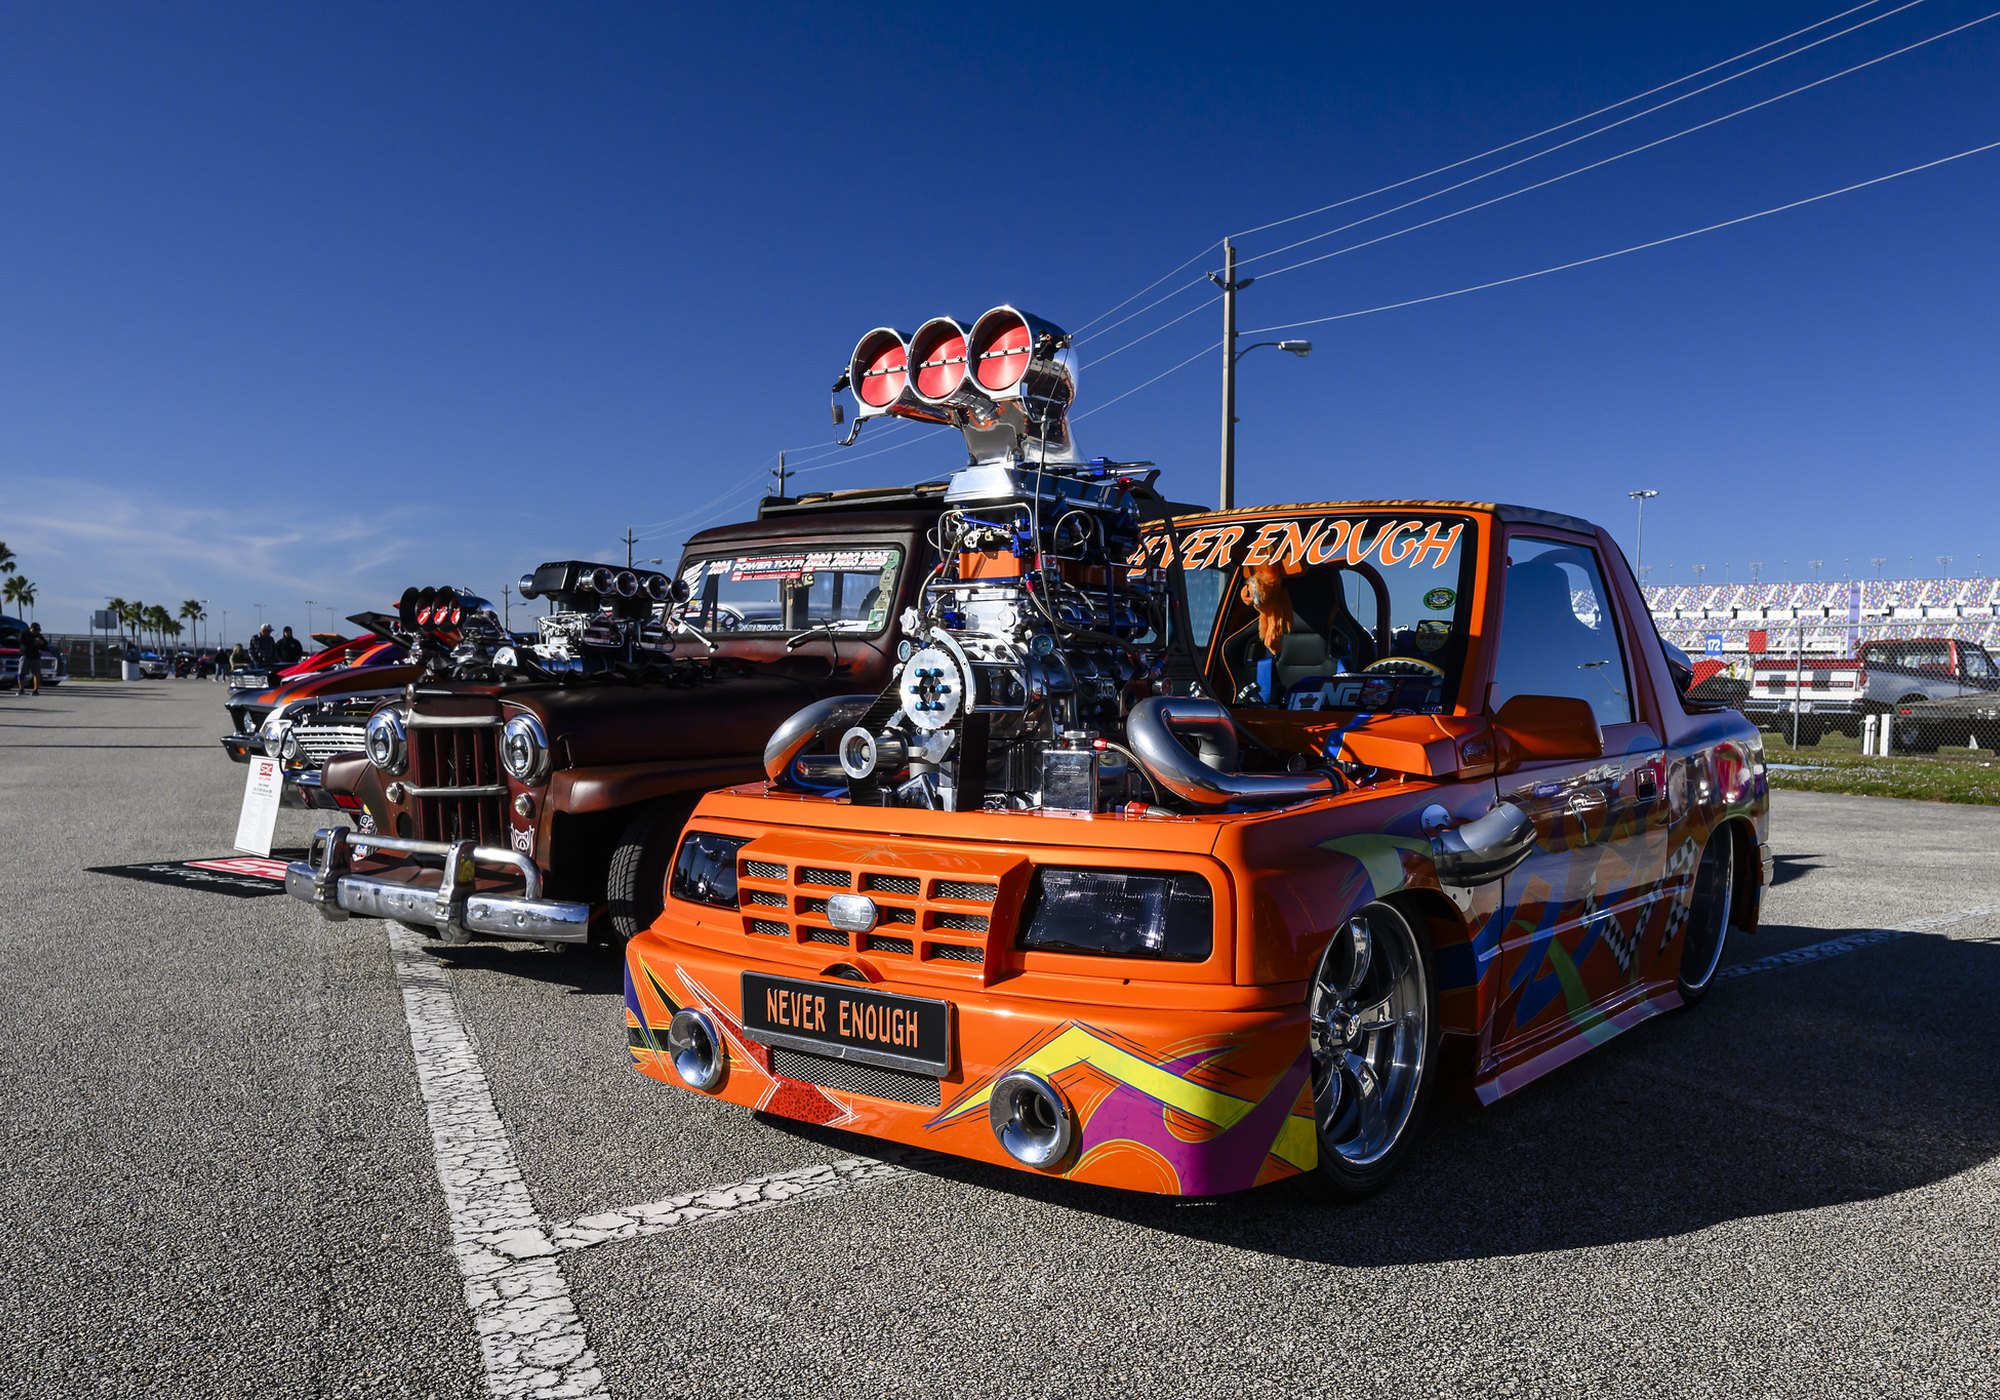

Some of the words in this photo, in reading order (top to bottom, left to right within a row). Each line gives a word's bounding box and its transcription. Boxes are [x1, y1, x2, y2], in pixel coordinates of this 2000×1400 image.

[1242, 518, 1464, 570] ENOUGH
[732, 561, 772, 571] POWER
[774, 559, 804, 568] TOUR
[1707, 639, 1720, 651] 172
[767, 988, 826, 1032] NEVER
[839, 1000, 918, 1048] ENOUGH
